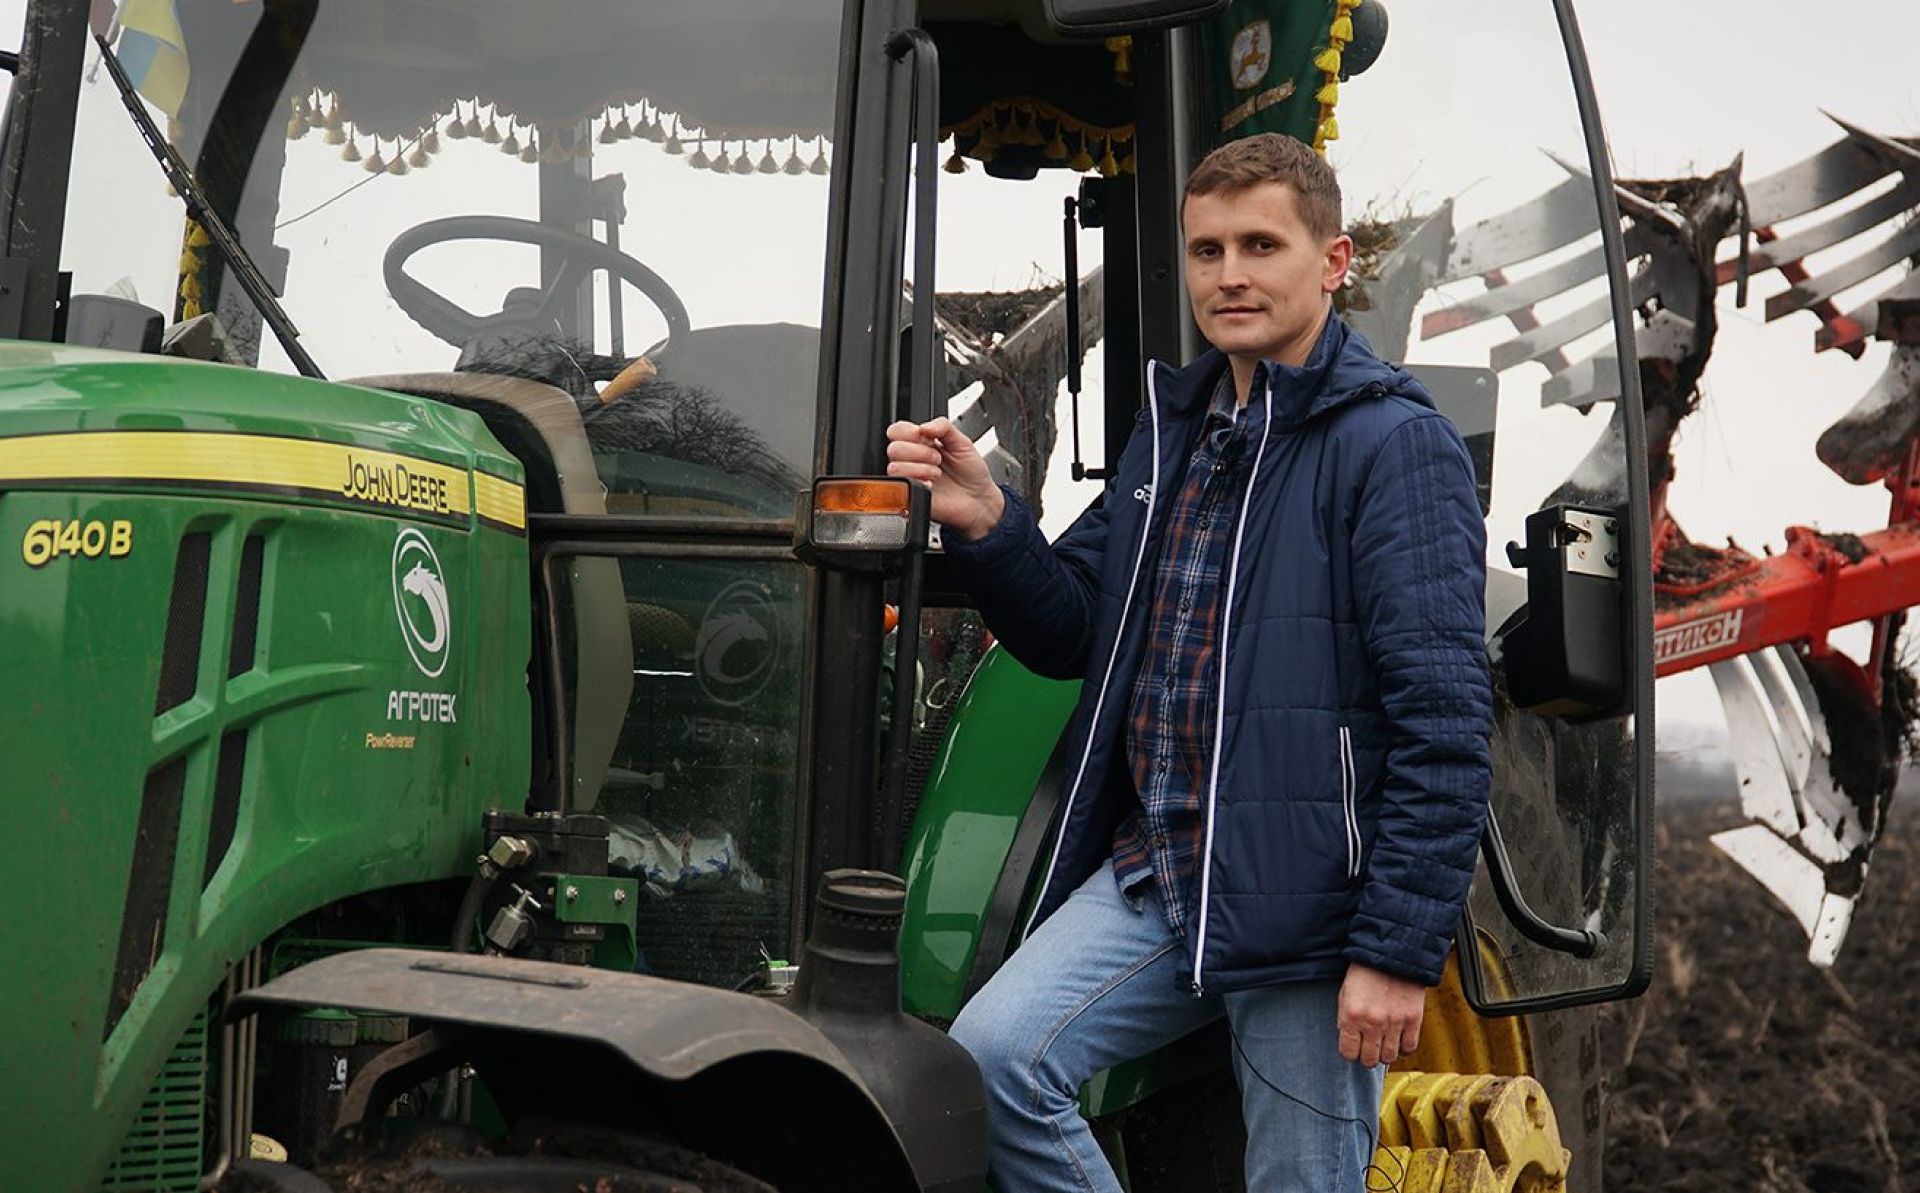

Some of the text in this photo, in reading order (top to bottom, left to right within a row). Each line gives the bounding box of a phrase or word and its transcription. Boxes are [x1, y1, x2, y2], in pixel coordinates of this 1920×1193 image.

[343, 454, 449, 513] JOHN DEERE
[22, 519, 132, 567] 6140 B
[387, 690, 456, 723] АГРОТЕК
